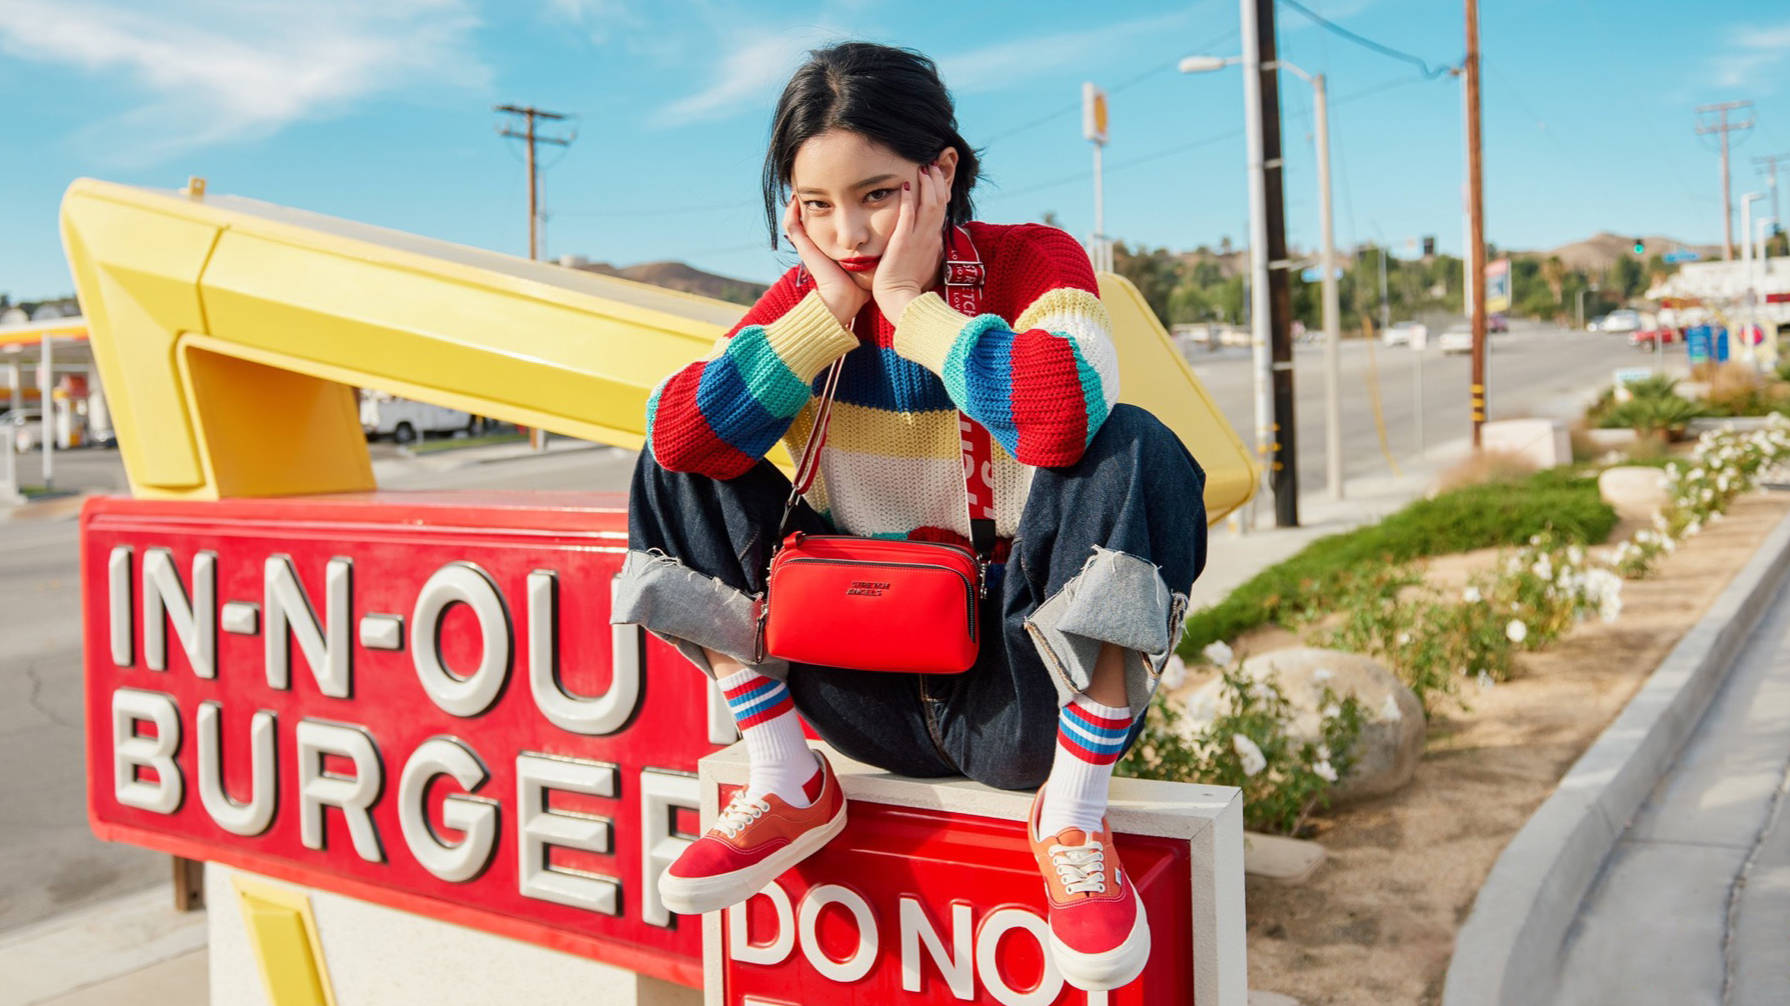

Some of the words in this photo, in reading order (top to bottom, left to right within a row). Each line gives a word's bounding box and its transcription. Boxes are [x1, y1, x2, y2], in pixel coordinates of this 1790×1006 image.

[962, 265, 978, 317] STRTCH
[109, 545, 740, 746] IN-N-OU
[729, 879, 879, 982] DO
[900, 897, 1108, 1006] NO
